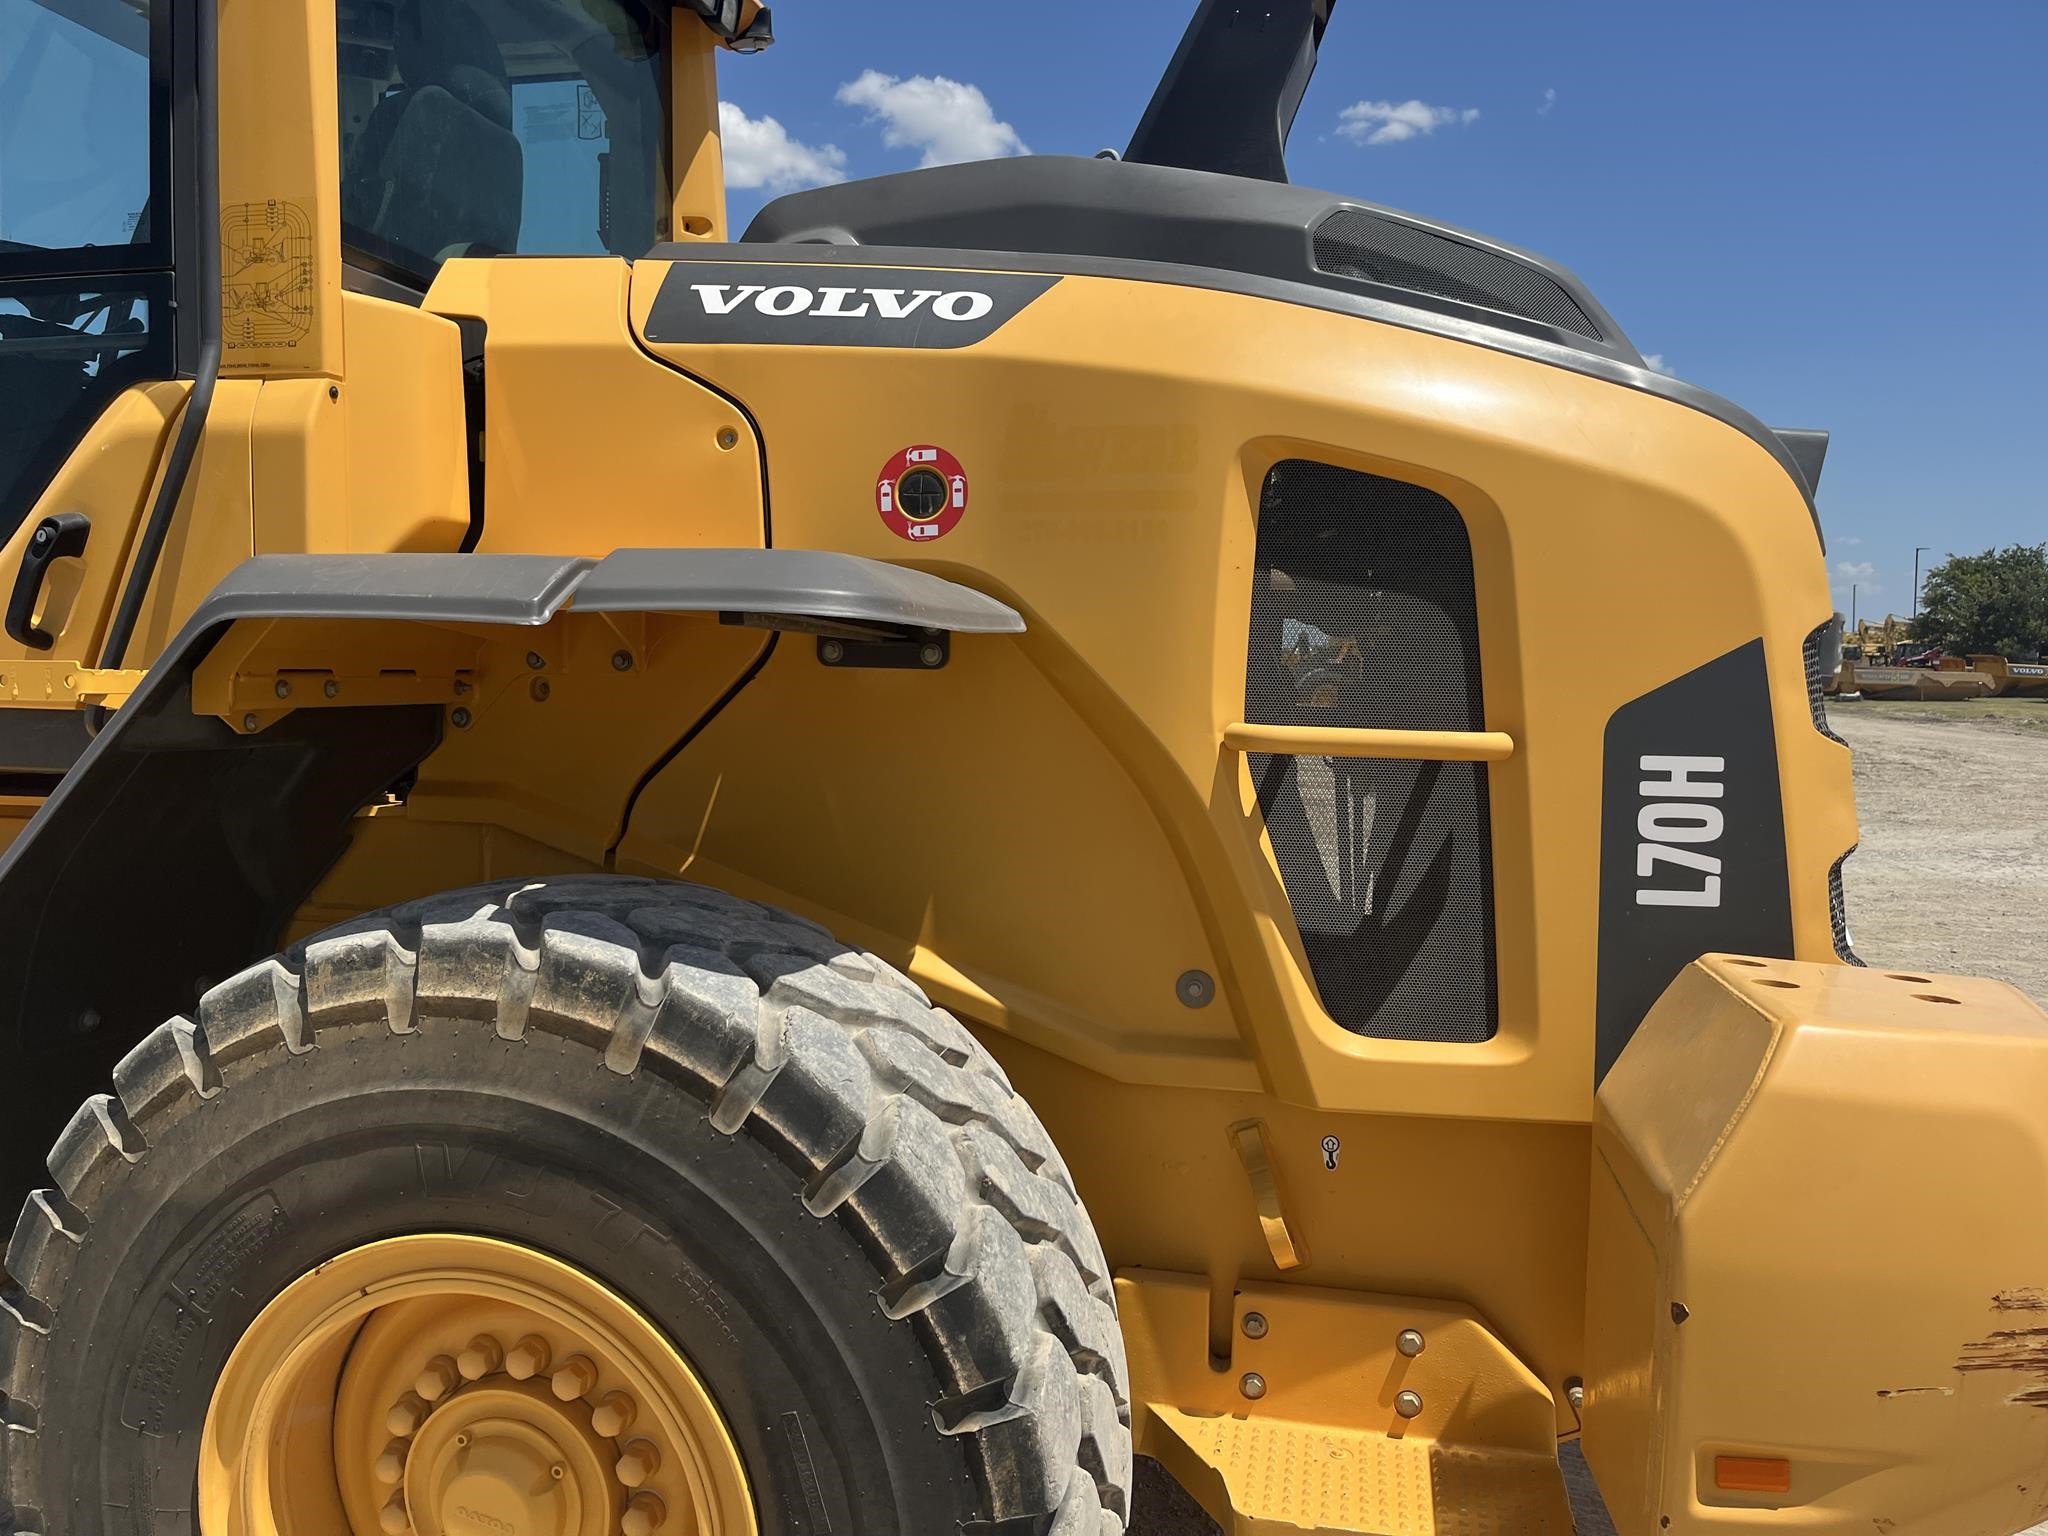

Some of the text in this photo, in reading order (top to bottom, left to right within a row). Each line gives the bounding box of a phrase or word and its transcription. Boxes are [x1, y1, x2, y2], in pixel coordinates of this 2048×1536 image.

[690, 284, 994, 321] VOLVO
[2012, 667, 2044, 675] VOLVO
[1636, 755, 1725, 907] L70H
